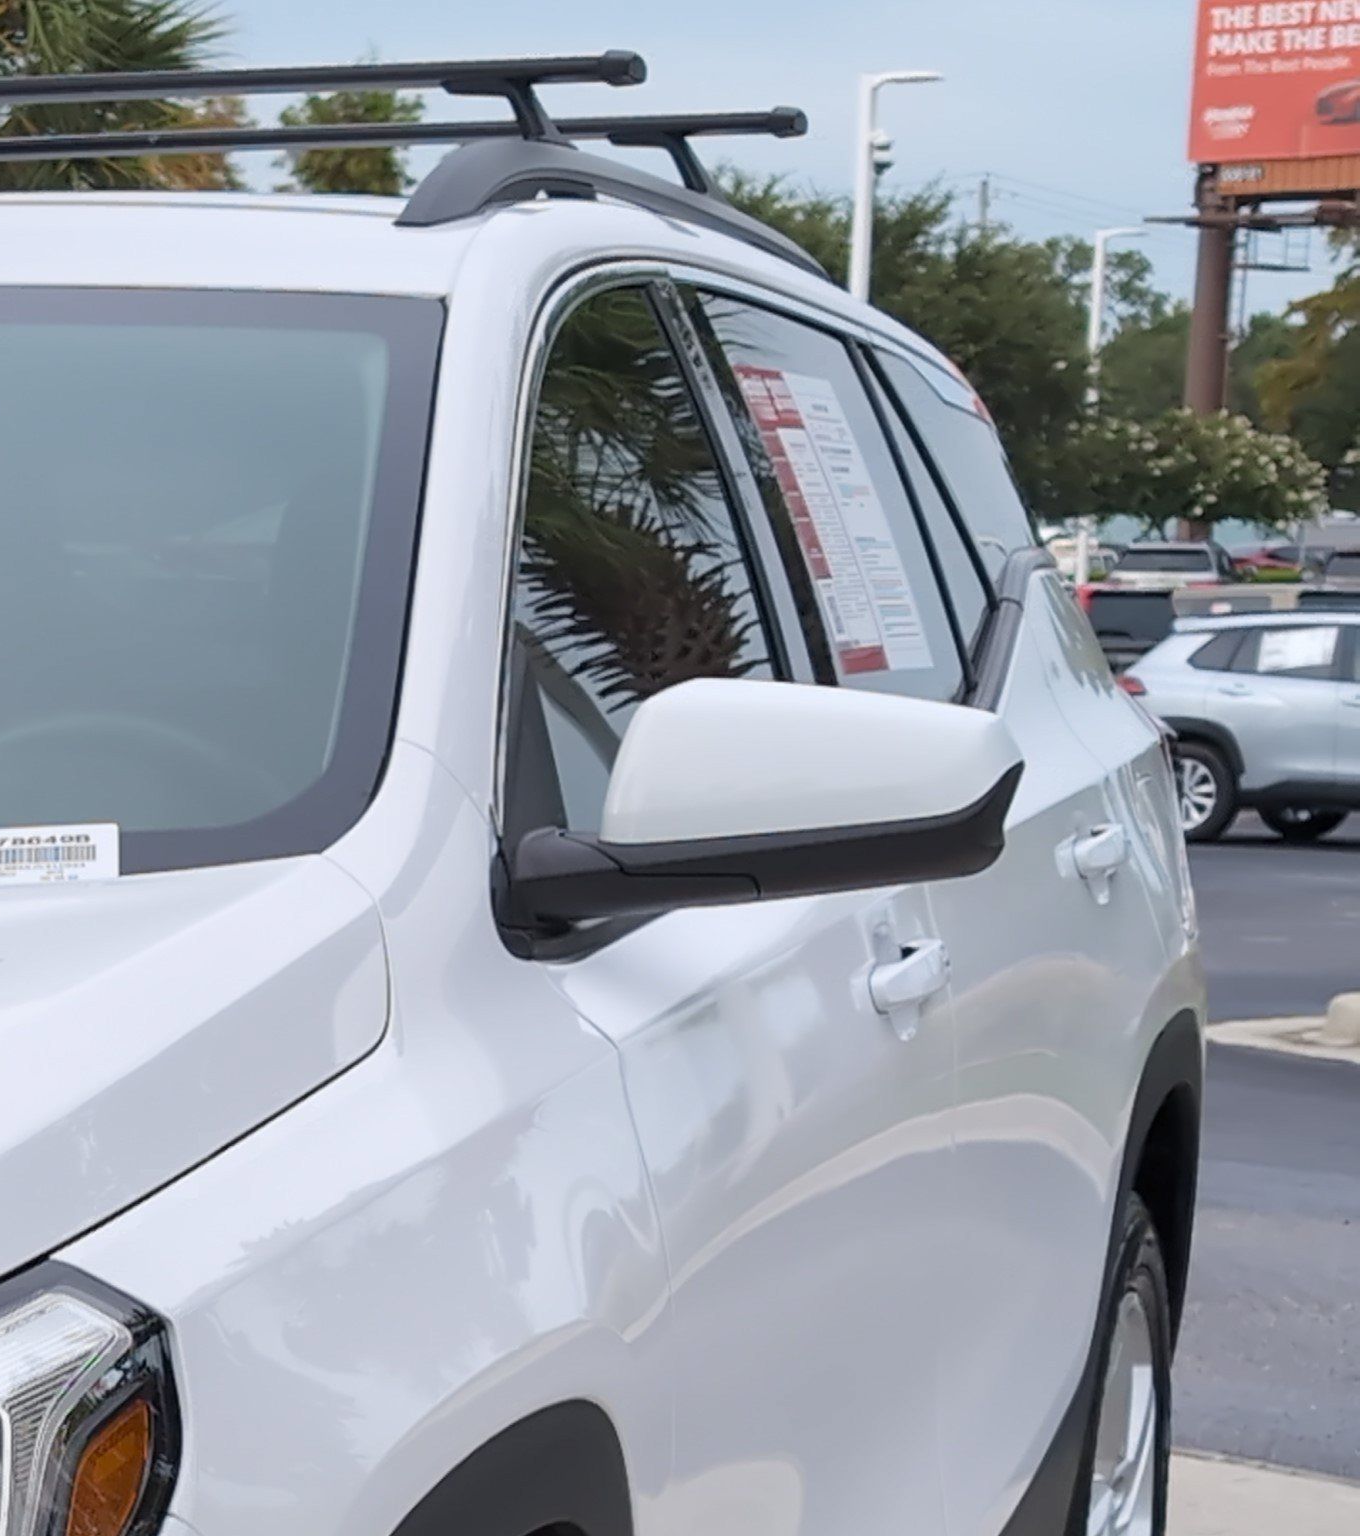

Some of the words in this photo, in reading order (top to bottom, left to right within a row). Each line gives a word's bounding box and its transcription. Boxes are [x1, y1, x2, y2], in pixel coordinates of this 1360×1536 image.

[1210, 7, 1255, 30] THE
[1259, 2, 1315, 27] BEST
[1208, 30, 1278, 56] MAKE
[1281, 27, 1326, 51] THE
